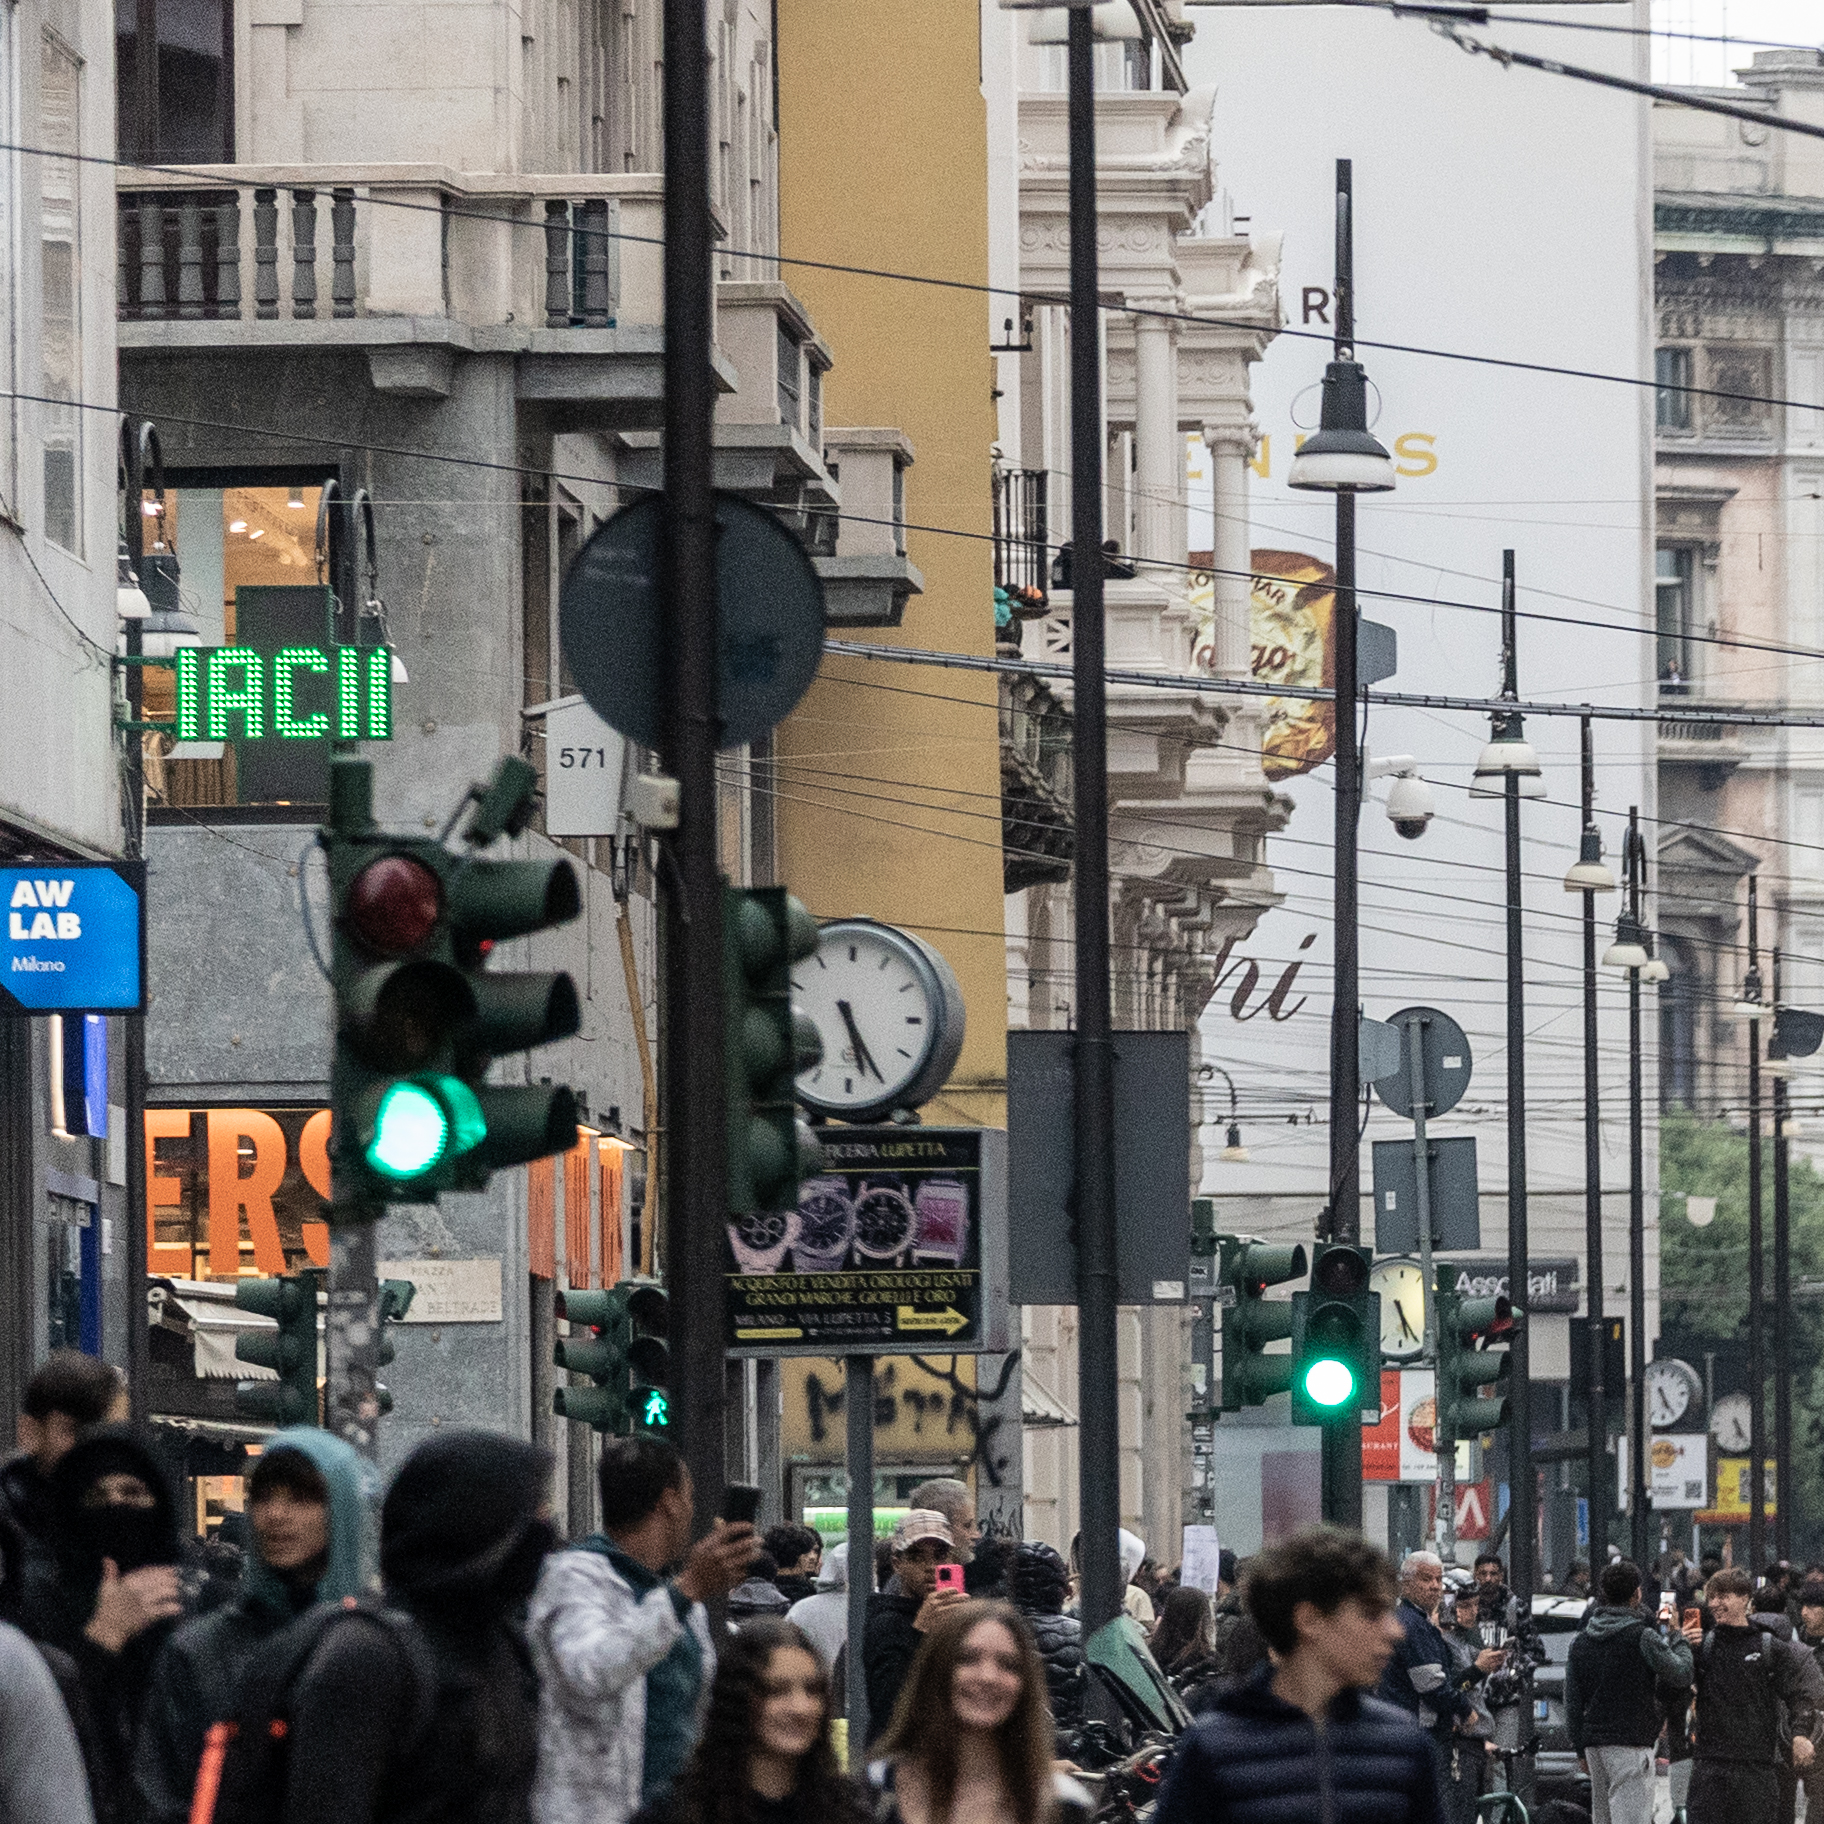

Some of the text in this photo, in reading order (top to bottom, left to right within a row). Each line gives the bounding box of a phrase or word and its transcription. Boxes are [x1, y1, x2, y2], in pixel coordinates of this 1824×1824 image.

[559, 746, 606, 769] 571
[10, 880, 75, 908] AW
[9, 912, 82, 940] LAB
[11, 955, 66, 973] Milano
